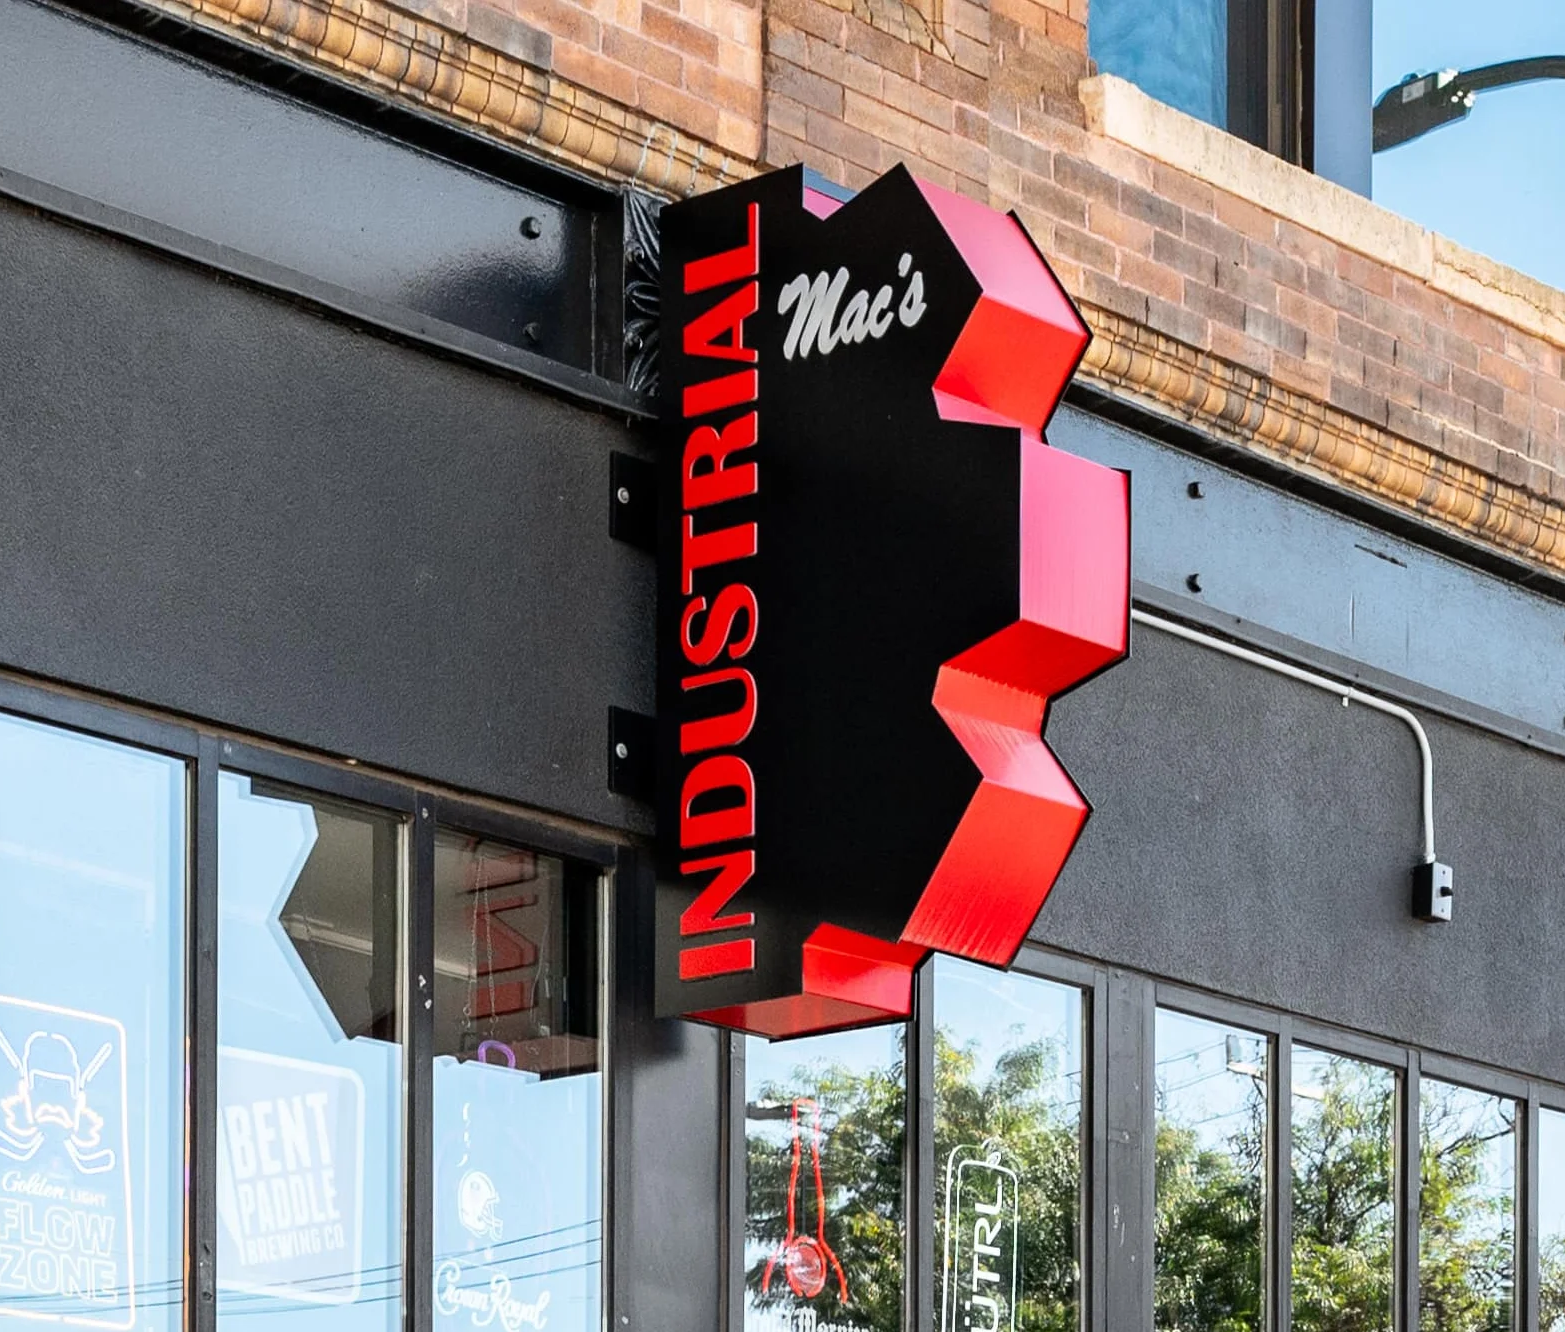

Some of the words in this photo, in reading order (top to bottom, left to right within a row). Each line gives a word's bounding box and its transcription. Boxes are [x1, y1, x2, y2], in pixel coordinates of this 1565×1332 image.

[778, 252, 927, 361] Mac's
[680, 203, 760, 981] INDUSTRIAL
[229, 1092, 331, 1180] BENT
[237, 1169, 341, 1240] PADDLE
[247, 1229, 322, 1265] BREWING
[434, 1258, 490, 1315] Crown
